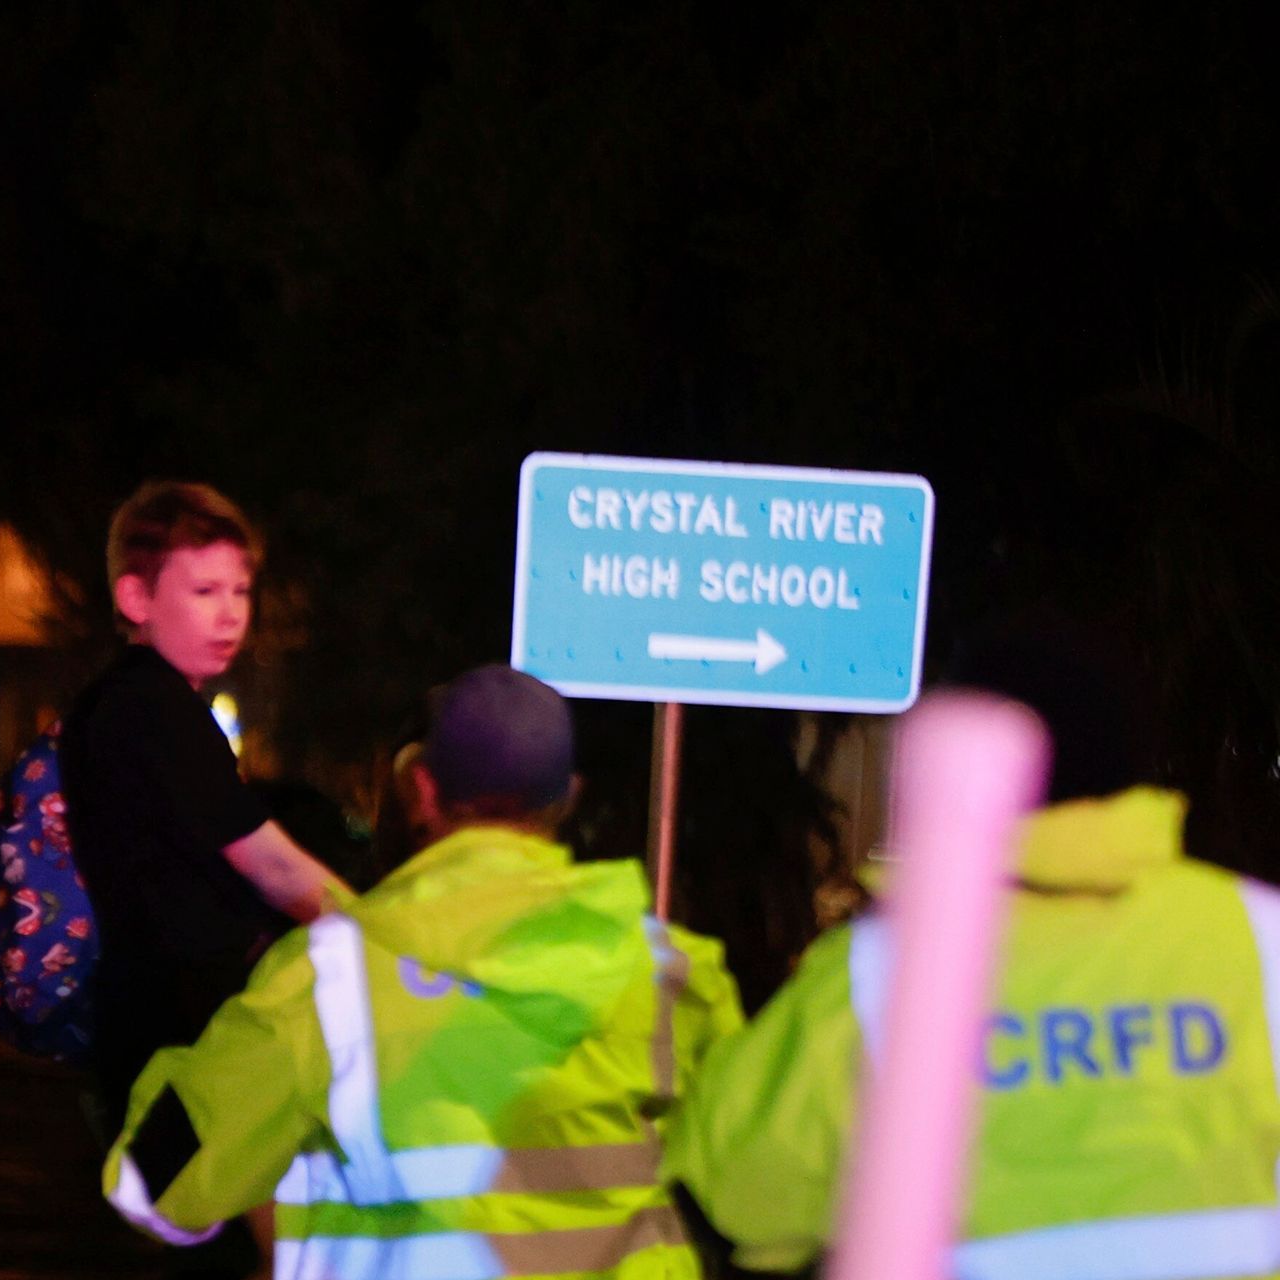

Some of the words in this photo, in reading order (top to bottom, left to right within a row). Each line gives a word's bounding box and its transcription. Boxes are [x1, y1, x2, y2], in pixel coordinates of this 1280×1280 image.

[567, 485, 749, 538] CRYSTAL
[768, 497, 886, 546] RIVER
[582, 553, 679, 600] HIGH
[699, 560, 861, 611] SCHOOL
[976, 1001, 1230, 1090] CRFD
